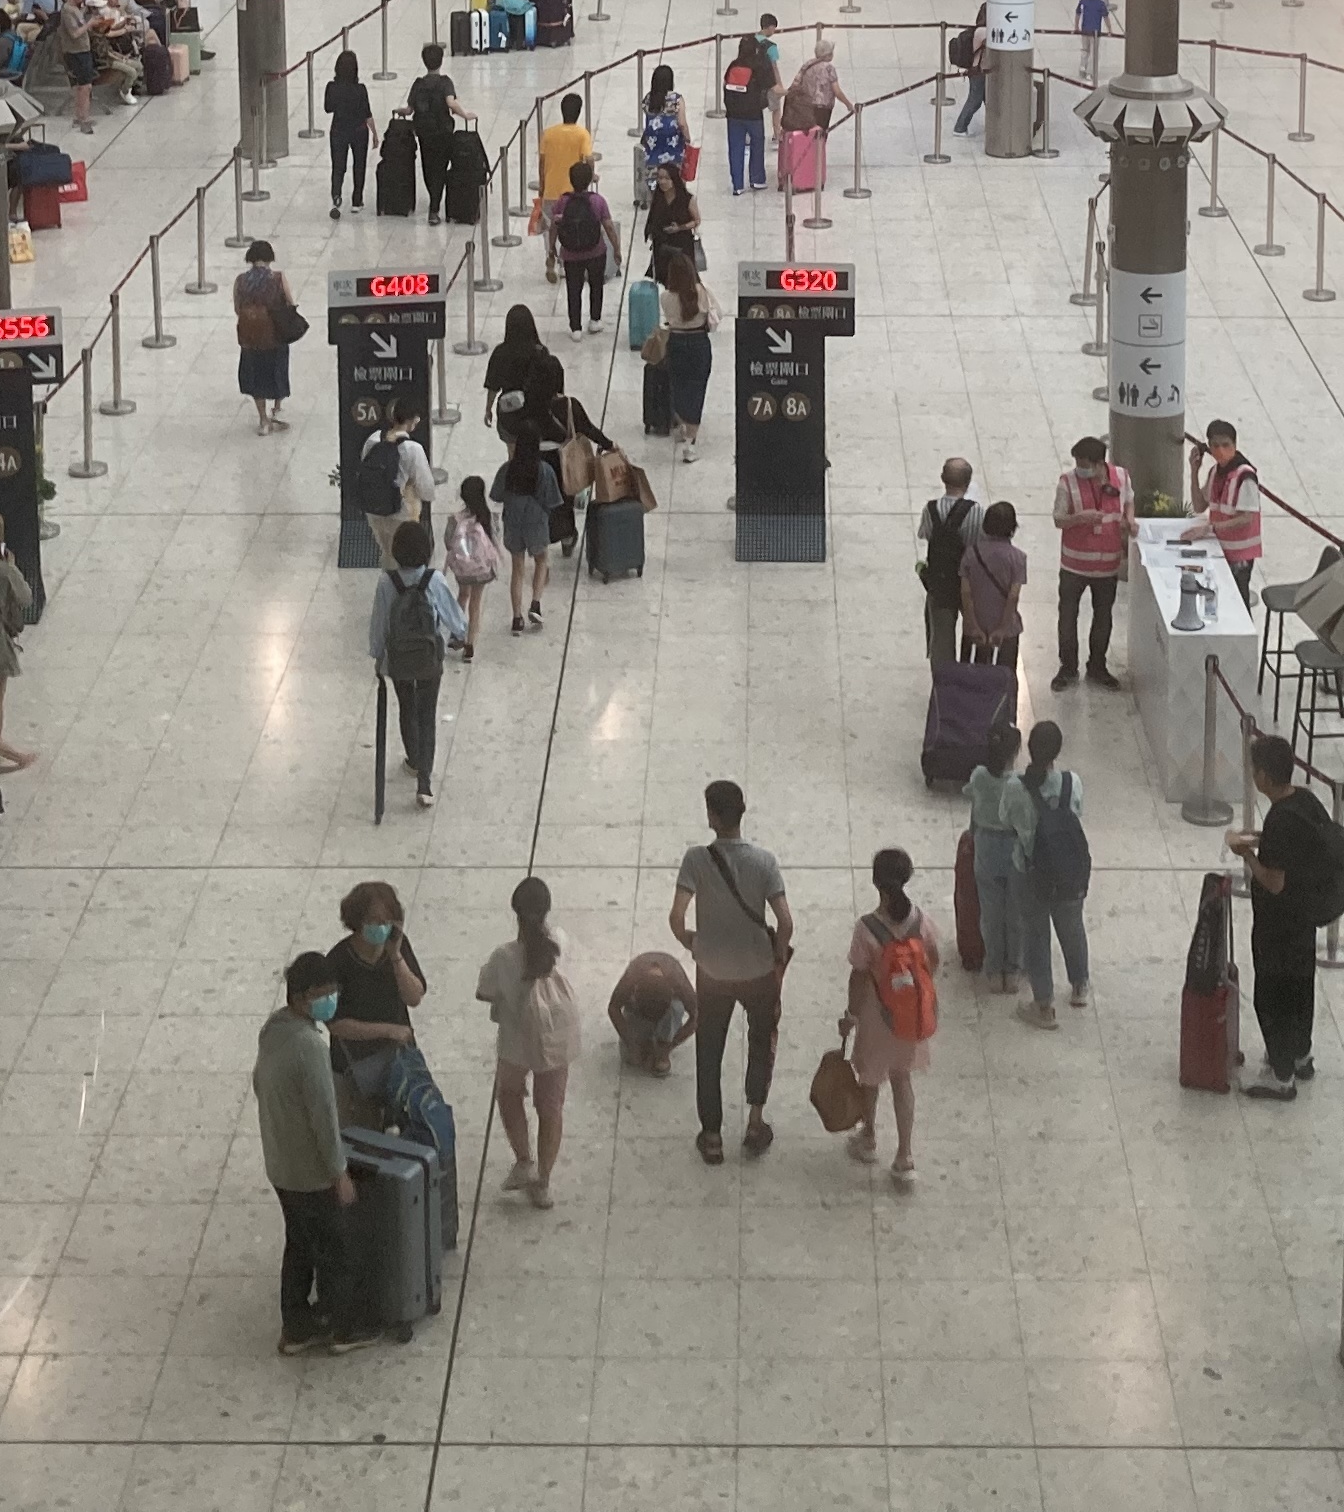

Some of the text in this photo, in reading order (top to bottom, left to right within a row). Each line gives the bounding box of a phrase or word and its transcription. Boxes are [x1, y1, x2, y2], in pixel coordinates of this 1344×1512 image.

[370, 273, 429, 298] G408
[780, 268, 837, 291] G320
[357, 402, 377, 421] 5A
[752, 397, 807, 416] 7A 8A
